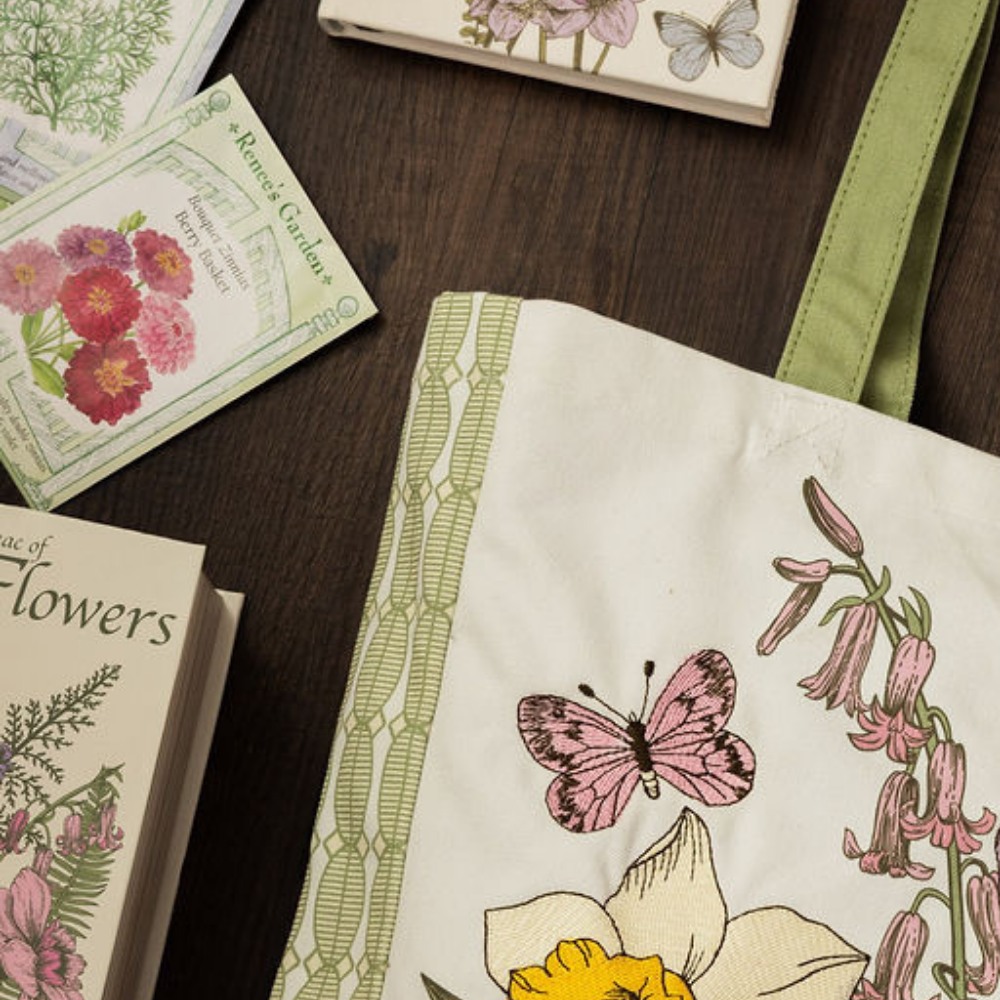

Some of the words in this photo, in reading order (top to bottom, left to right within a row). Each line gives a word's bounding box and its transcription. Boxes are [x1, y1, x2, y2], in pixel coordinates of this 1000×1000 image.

[187, 194, 222, 246] Bouquet
[218, 244, 250, 291] Zinnias
[235, 131, 285, 201] Renee's
[279, 201, 326, 276] Garden
[175, 210, 203, 249] Berry
[199, 248, 231, 293] Basket
[0, 534, 24, 551] ac
[29, 535, 54, 563] of
